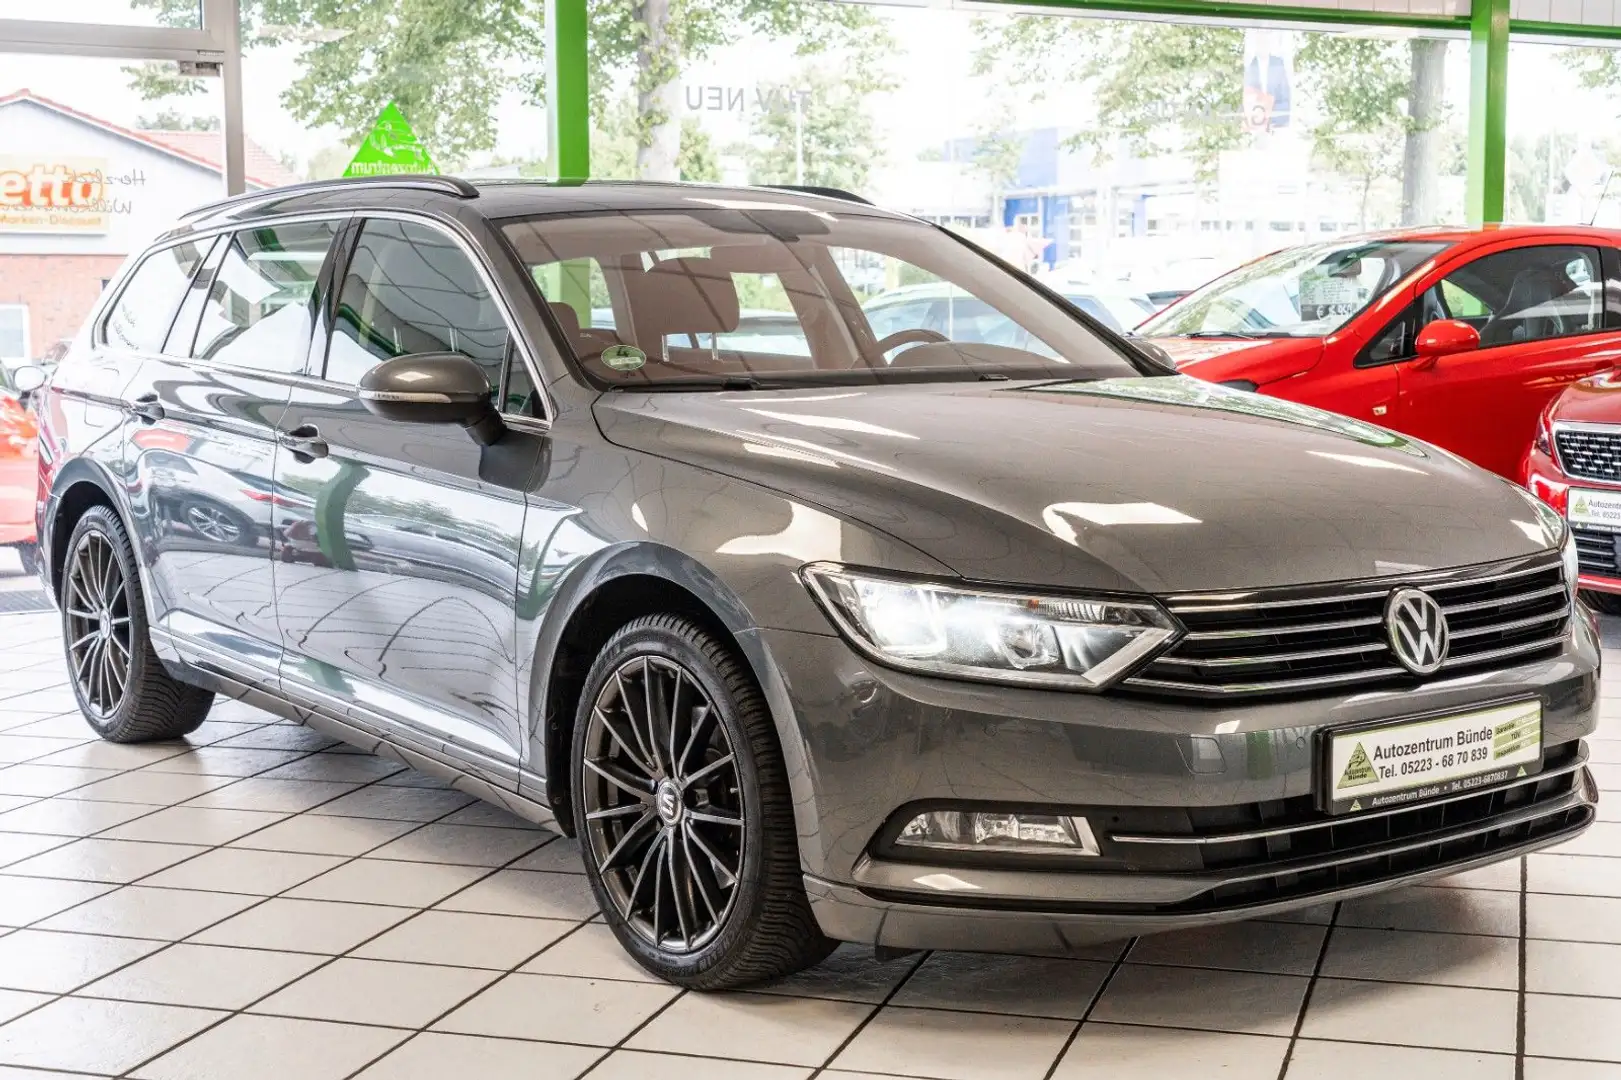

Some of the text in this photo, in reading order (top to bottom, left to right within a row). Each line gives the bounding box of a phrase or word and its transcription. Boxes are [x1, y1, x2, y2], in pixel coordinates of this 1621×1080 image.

[1373, 734, 1453, 761] Autozentrum
[1456, 725, 1493, 746] Bünde
[1379, 765, 1398, 780] Tel.
[1400, 758, 1433, 776] 05223
[1441, 753, 1454, 768] 68
[1456, 750, 1468, 765] 70
[1470, 746, 1488, 762] 839
[1371, 791, 1418, 807] Autozentrum
[1418, 786, 1440, 798] Bünde
[1451, 782, 1462, 791] Tel.
